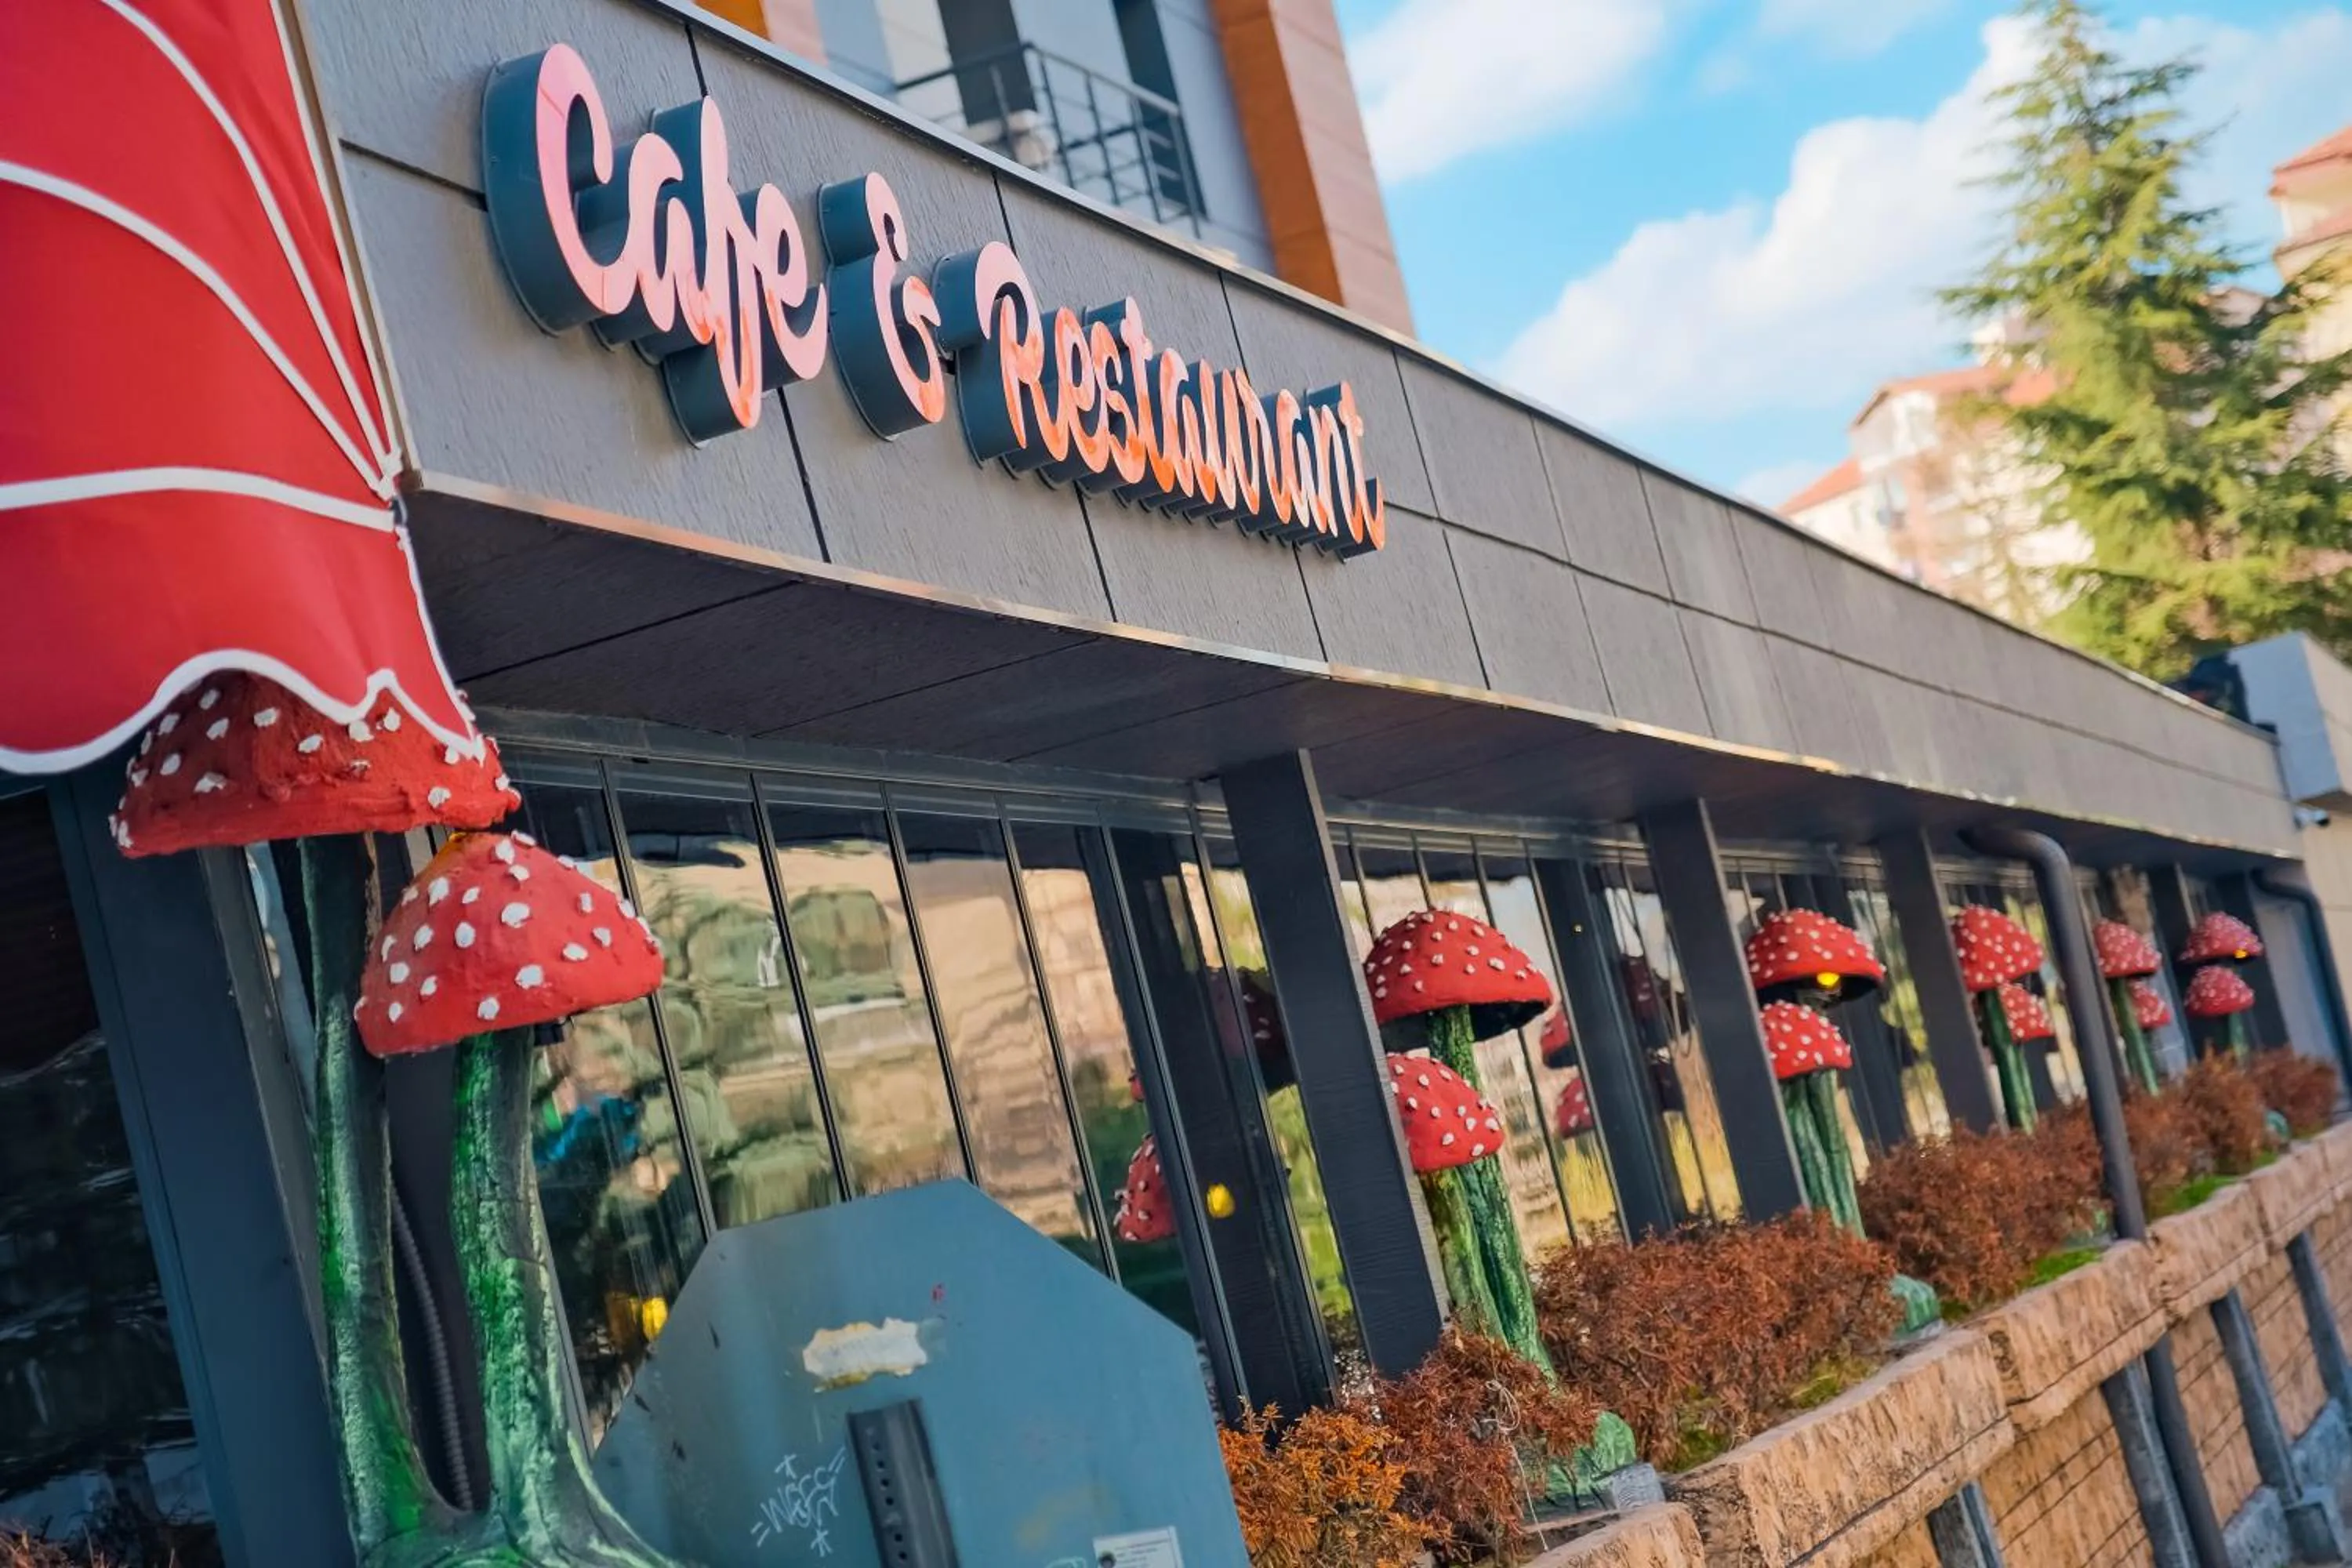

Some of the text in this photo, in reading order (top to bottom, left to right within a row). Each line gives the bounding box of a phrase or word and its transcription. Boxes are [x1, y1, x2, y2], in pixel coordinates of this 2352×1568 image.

[536, 43, 1385, 550] Cafe & Restaurant
